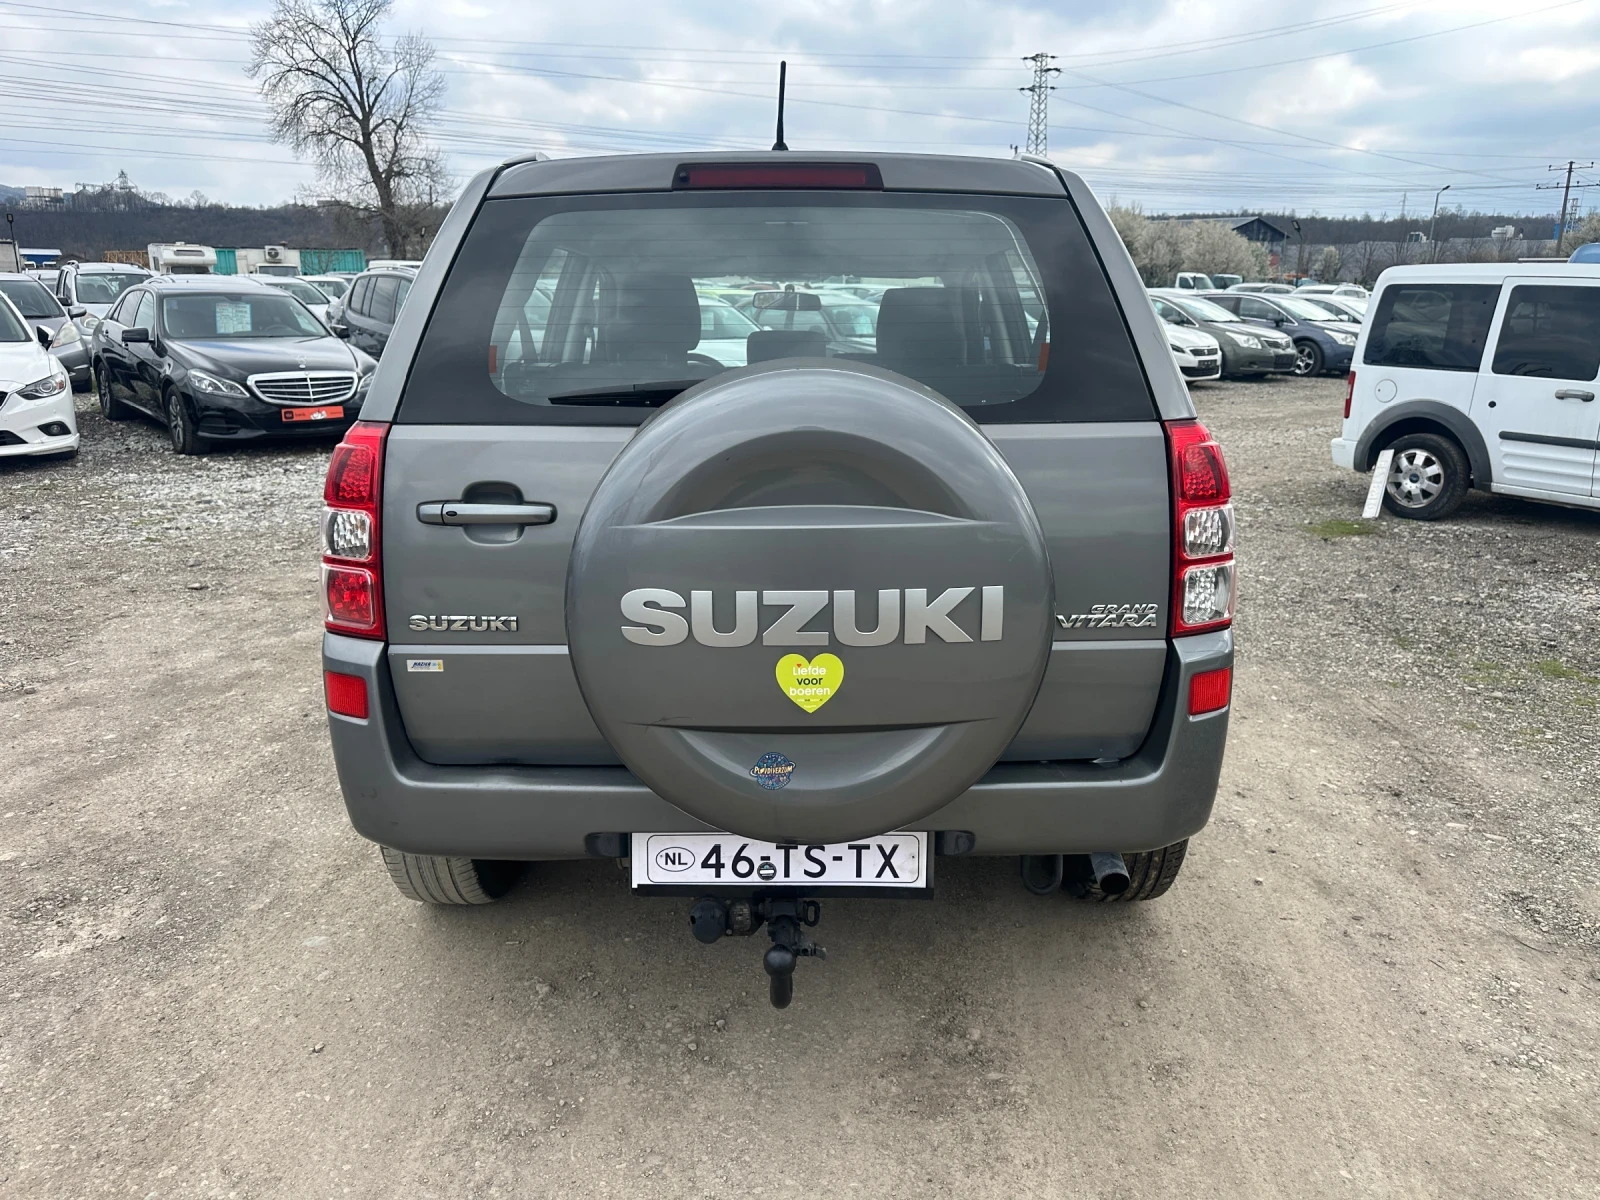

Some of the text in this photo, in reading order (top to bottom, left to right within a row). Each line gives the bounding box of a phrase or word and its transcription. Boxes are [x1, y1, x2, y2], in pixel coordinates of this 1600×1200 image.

[1090, 603, 1158, 614] GRAND
[409, 614, 519, 632] SUZUKI
[620, 585, 1004, 648] SUZUKI
[1056, 613, 1157, 629] VITARA
[792, 665, 827, 676] Liefde
[796, 677, 823, 686] voor
[789, 687, 831, 696] boeren
[663, 843, 900, 879] NL 46-TS-TX
